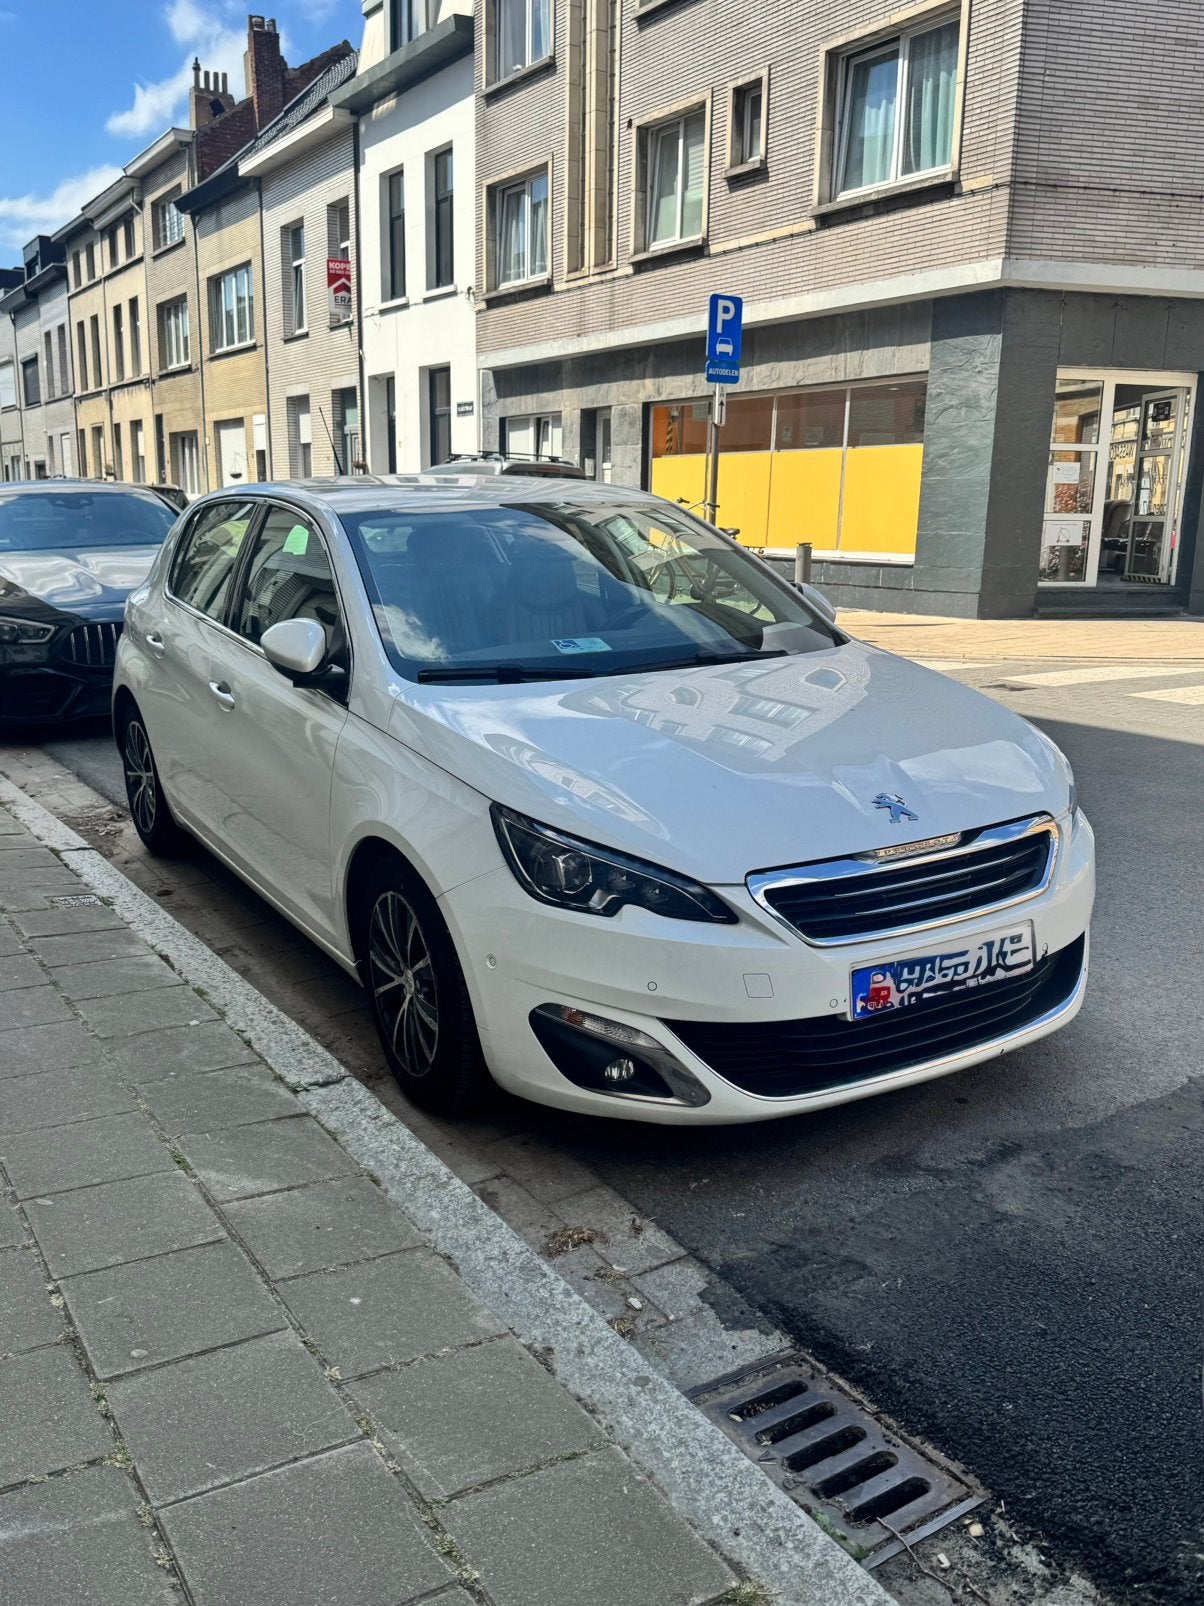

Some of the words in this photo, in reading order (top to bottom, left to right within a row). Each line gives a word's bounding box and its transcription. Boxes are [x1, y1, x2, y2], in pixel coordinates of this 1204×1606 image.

[716, 299, 736, 334] P
[708, 367, 739, 377] AUTODELEN
[884, 836, 949, 856] PEUGEOT
